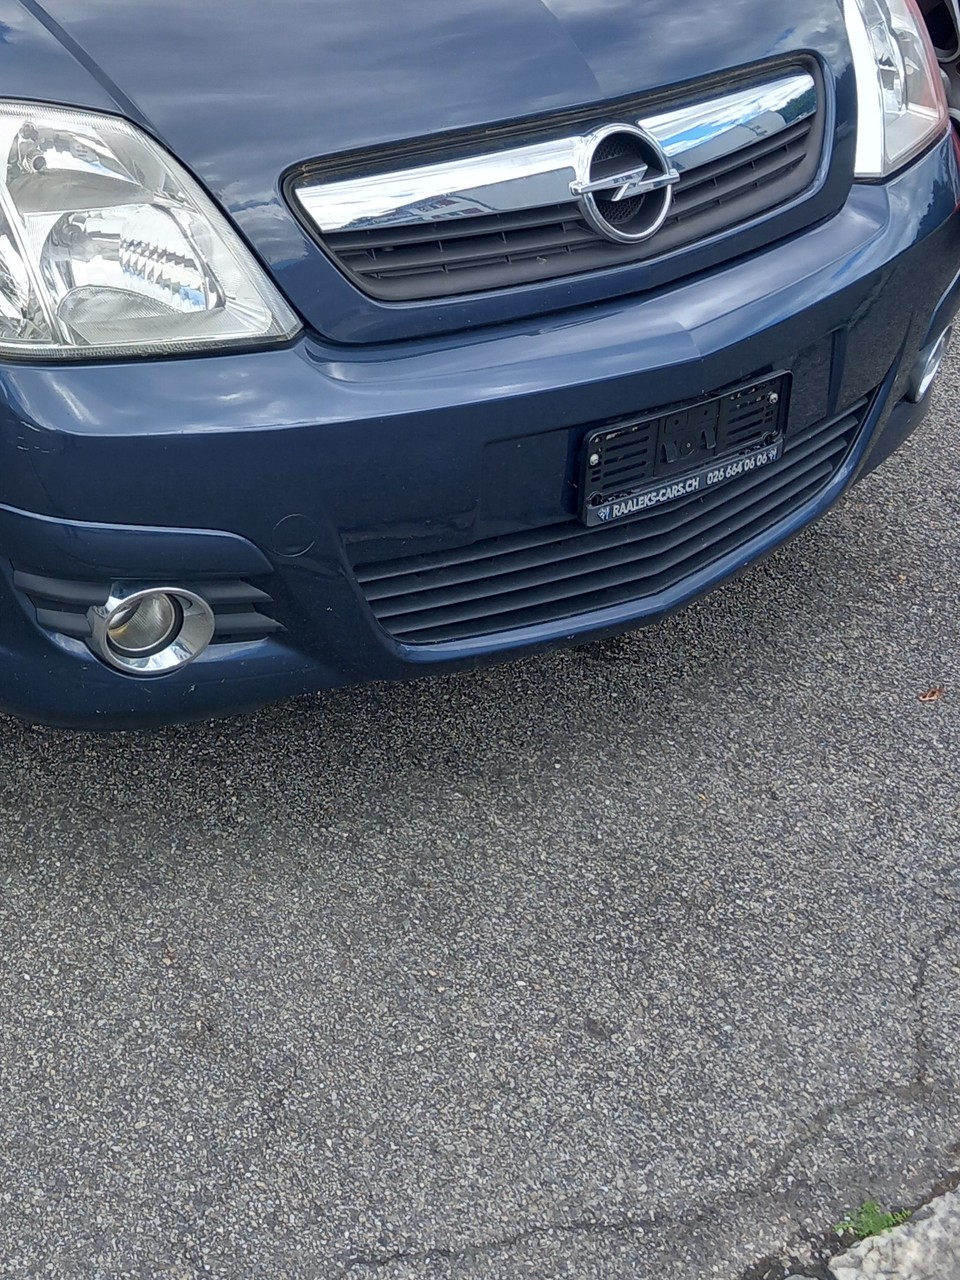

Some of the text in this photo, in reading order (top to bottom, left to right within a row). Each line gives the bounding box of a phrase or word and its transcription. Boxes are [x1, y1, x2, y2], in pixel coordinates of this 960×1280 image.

[612, 453, 767, 517] RAALEKS-CARS.CH 026 664 06 06
